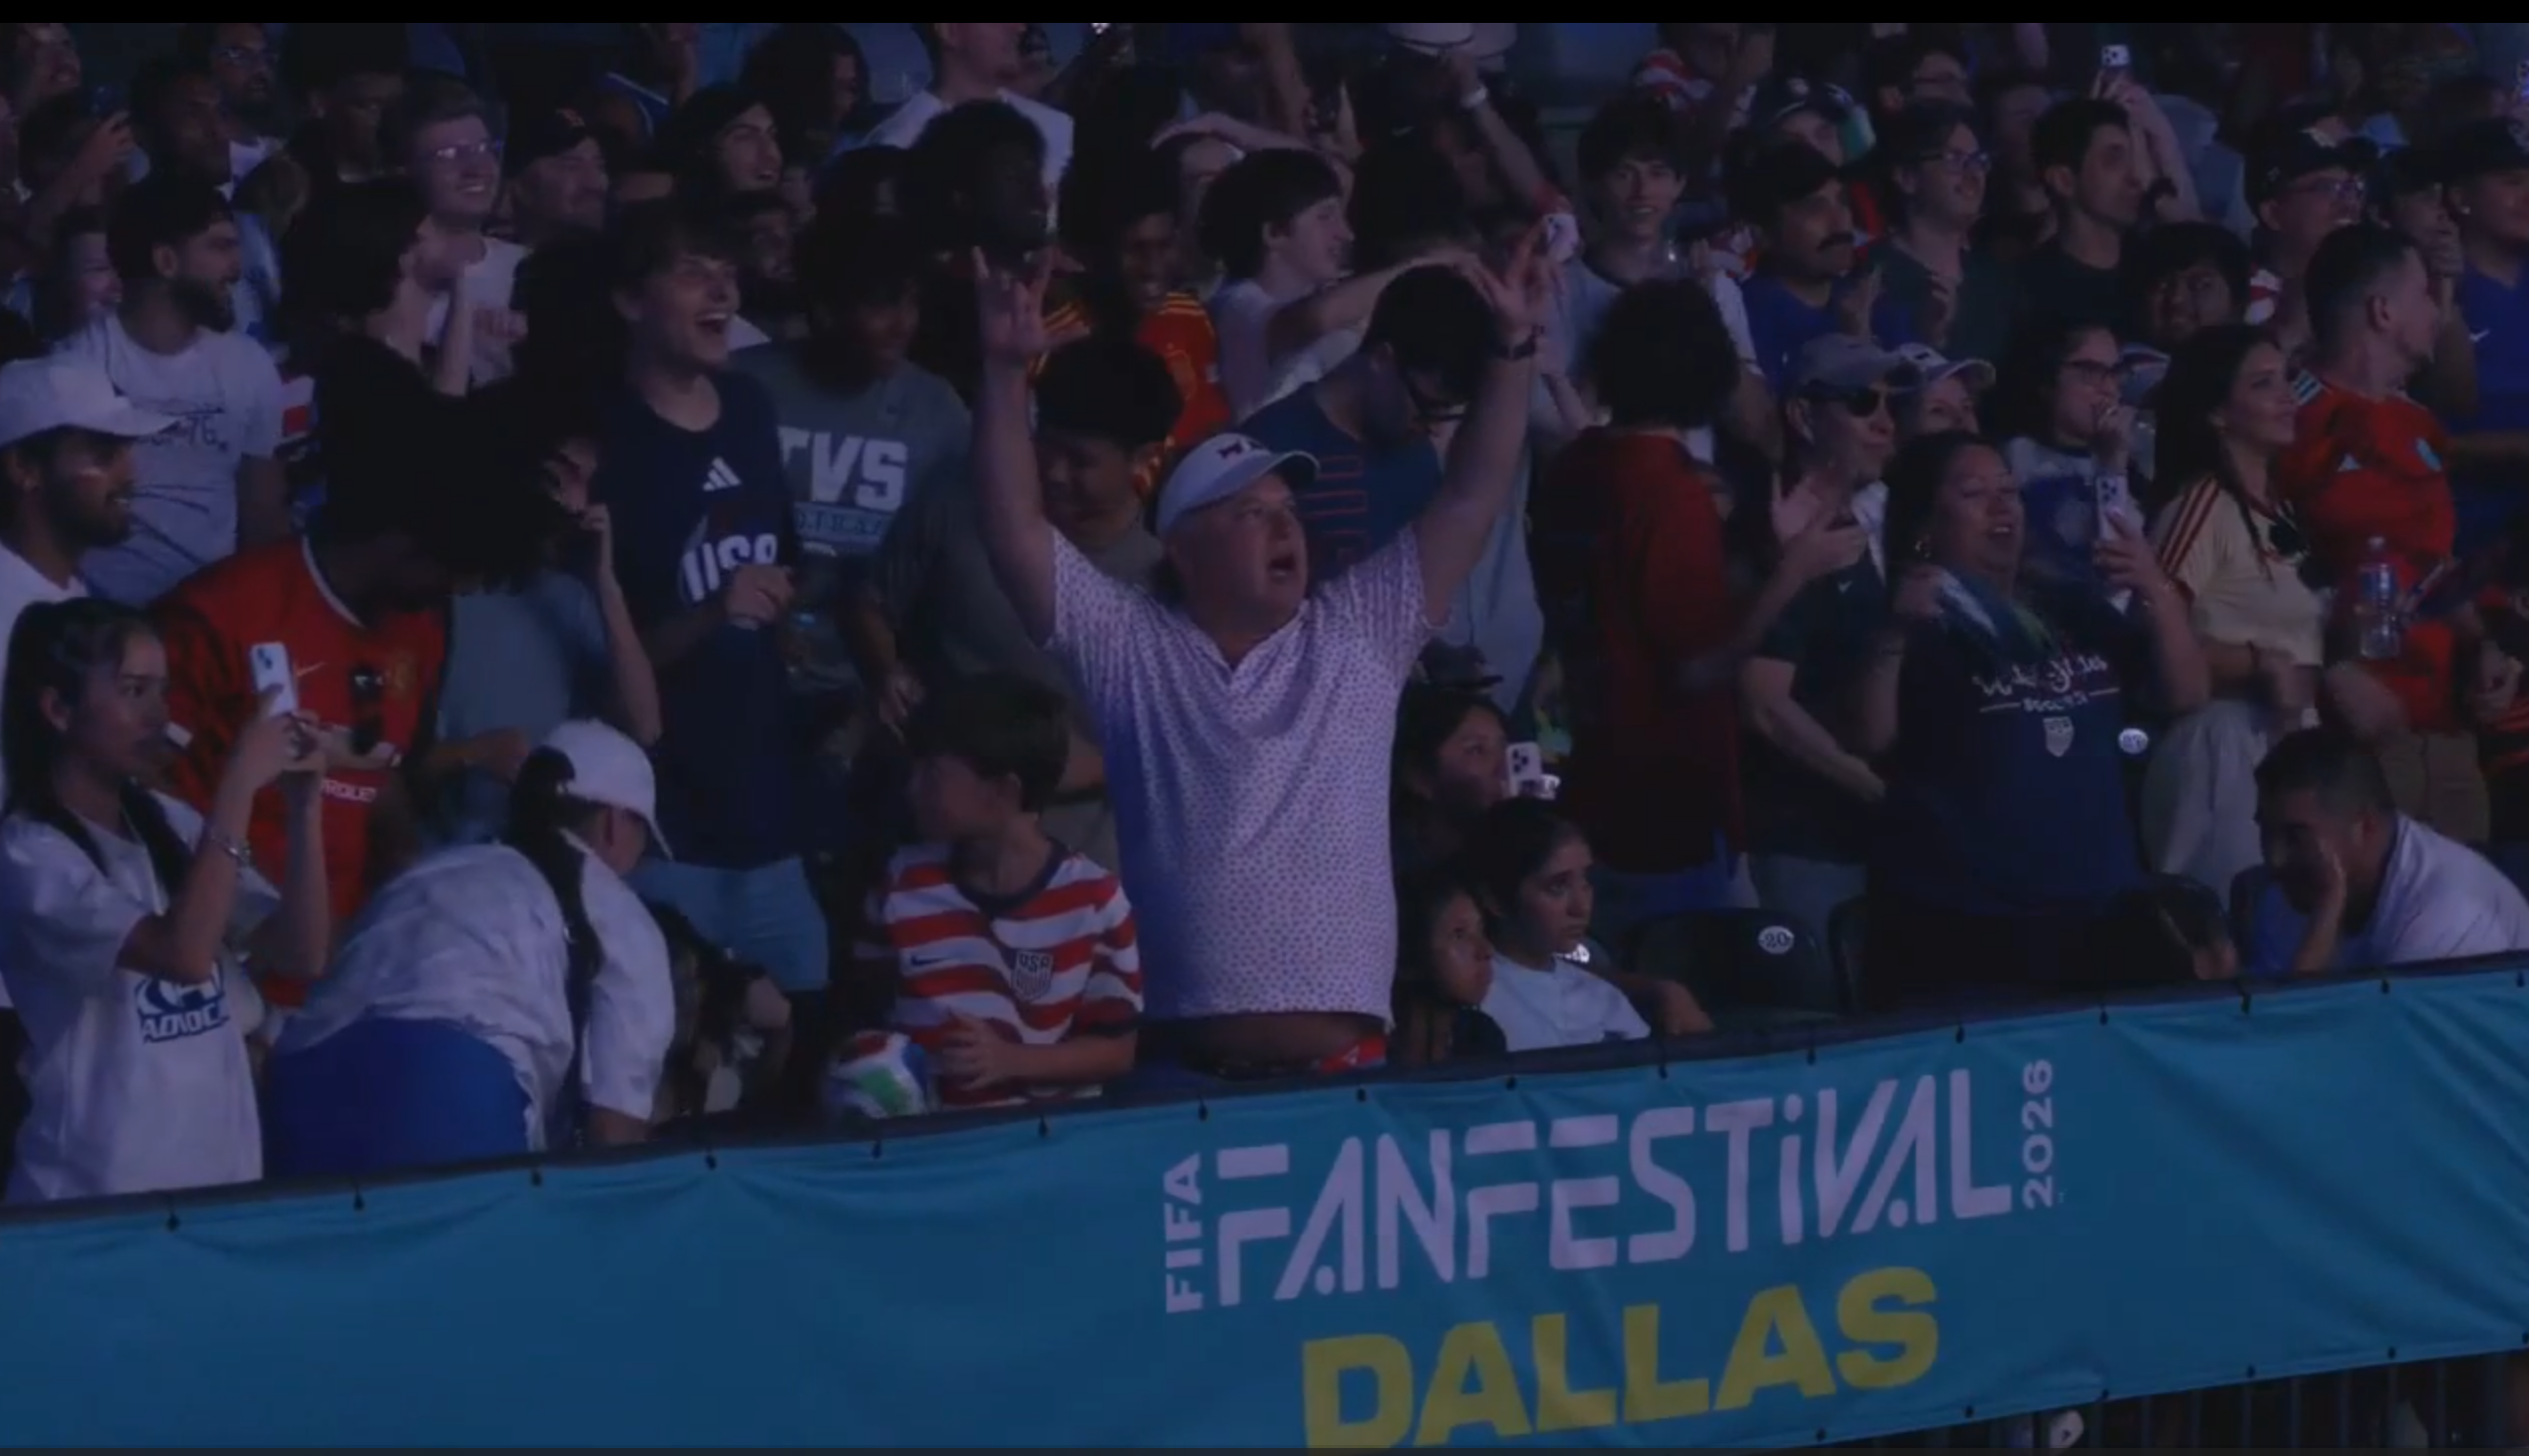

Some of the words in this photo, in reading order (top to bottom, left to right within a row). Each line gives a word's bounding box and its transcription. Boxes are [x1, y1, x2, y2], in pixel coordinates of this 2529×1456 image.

[2022, 1058, 2054, 1208] 2026
[1164, 1153, 1203, 1313] FIFA
[1302, 1266, 1940, 1455] DALLAS
